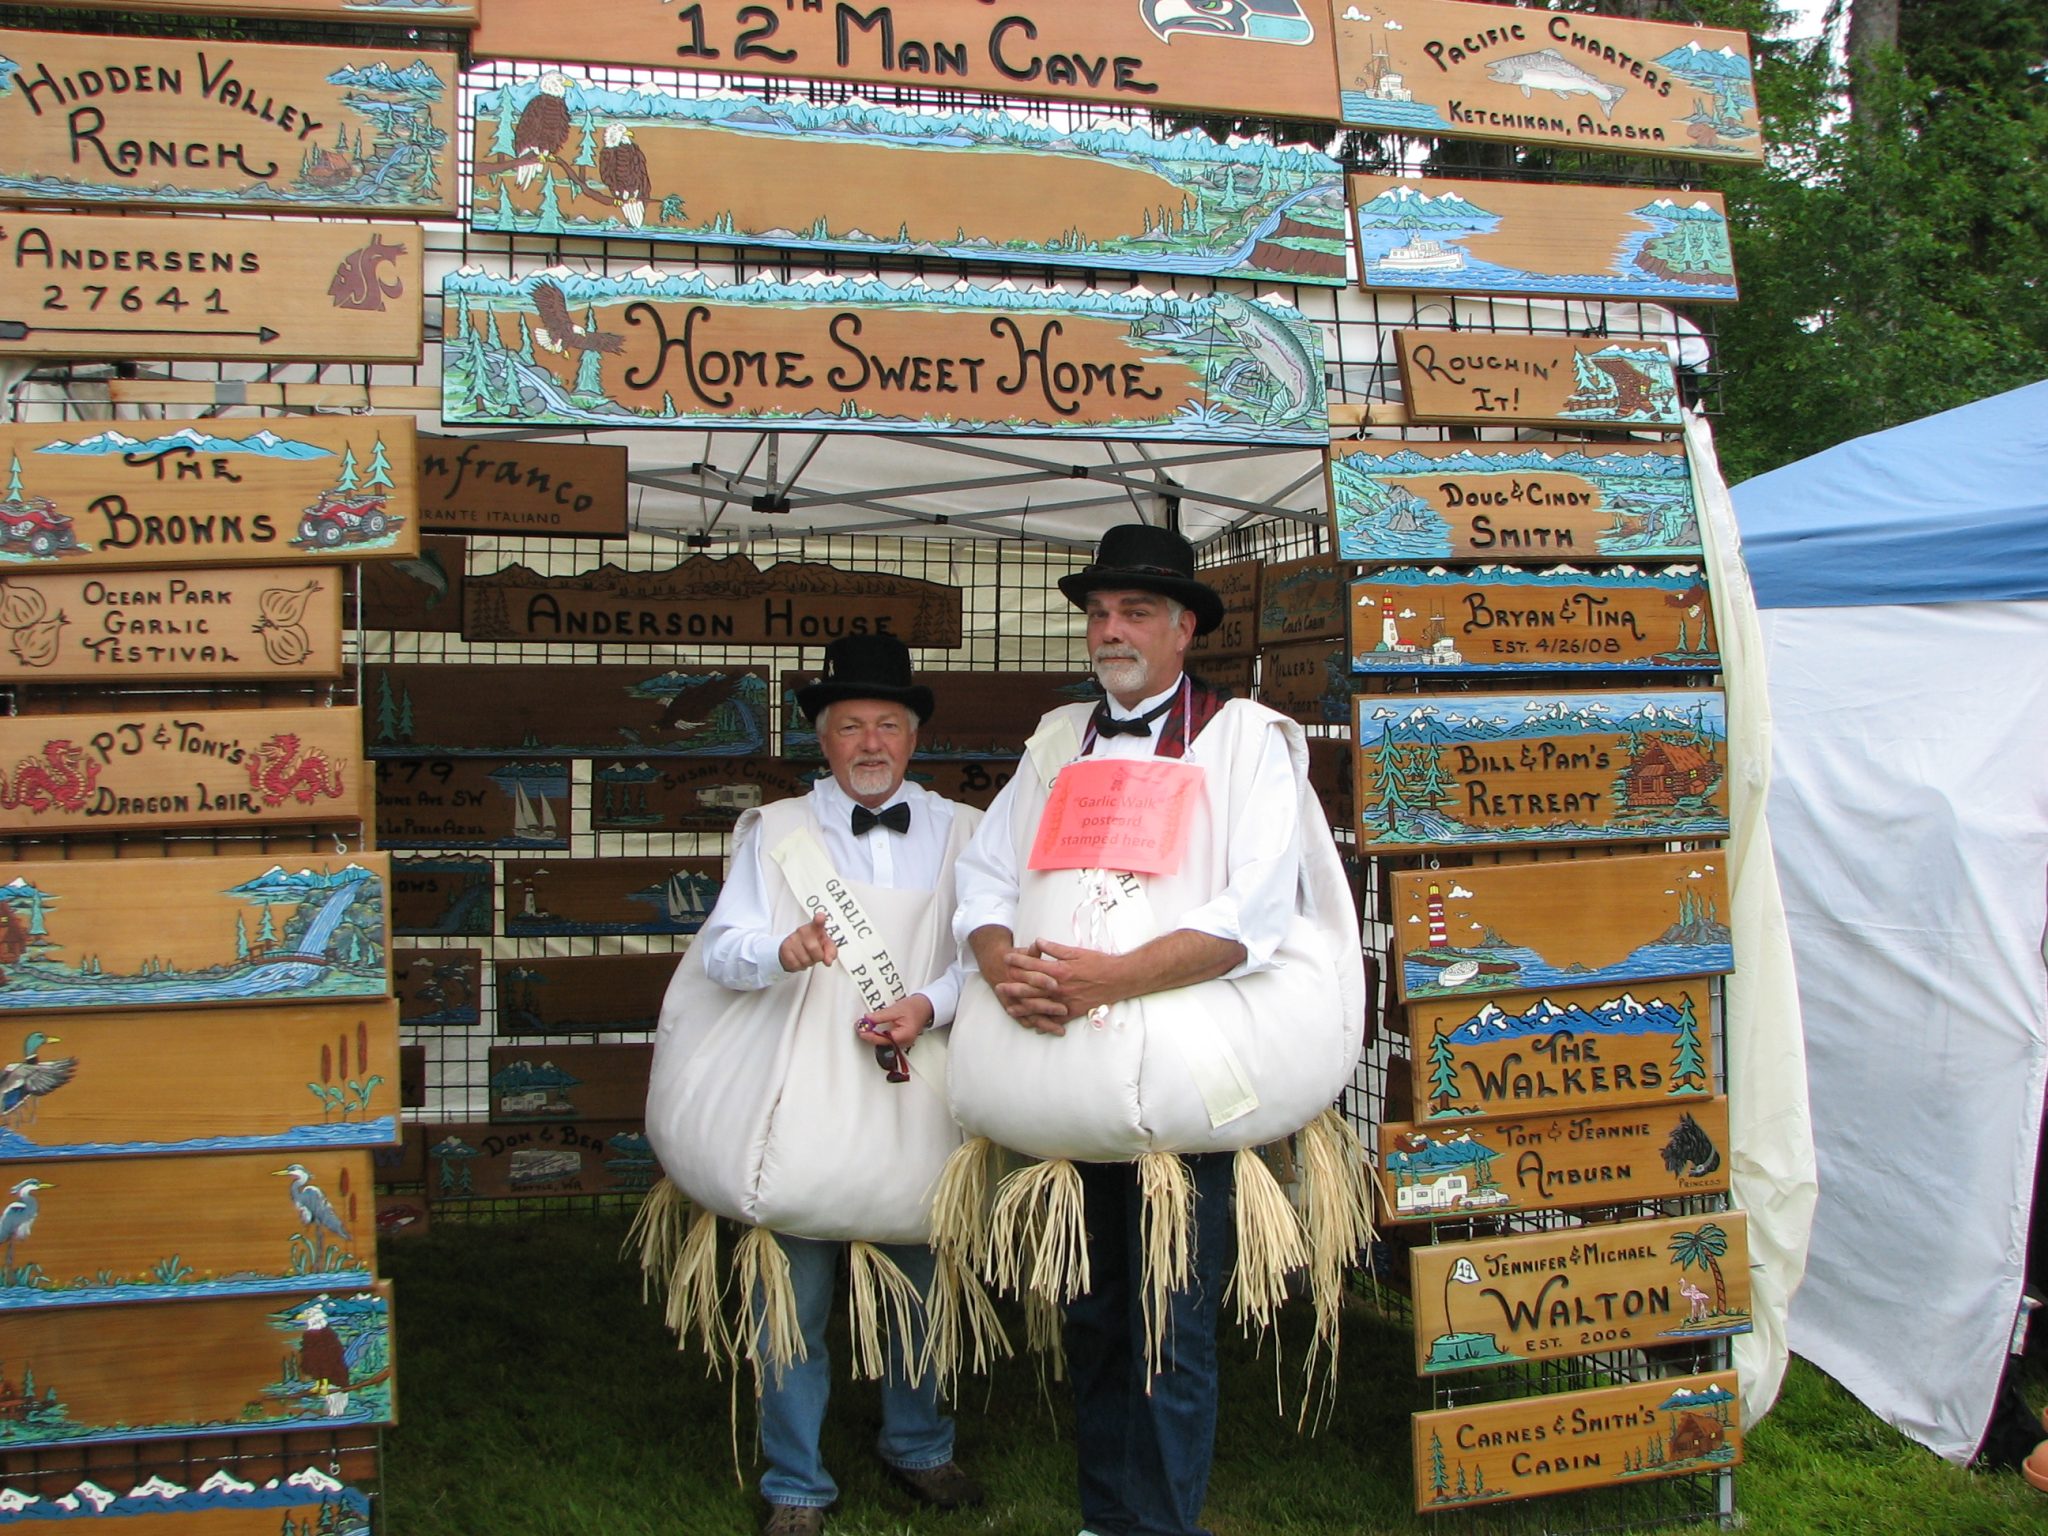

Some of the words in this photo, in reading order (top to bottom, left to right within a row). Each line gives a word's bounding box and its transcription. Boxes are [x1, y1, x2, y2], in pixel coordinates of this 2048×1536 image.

[836, 2, 968, 78] MAN
[989, 16, 1159, 93] CAVE
[1423, 23, 1527, 72] PACIFIC
[1548, 16, 1672, 98] CHARTERS
[14, 62, 183, 116] HIDDEN
[198, 52, 324, 140] VALLEY
[1448, 100, 1572, 136] KETCHIKAN,
[1577, 114, 1665, 142] ALASKA
[69, 106, 279, 178] RANCH
[16, 227, 260, 273] ANDERSENS
[44, 285, 230, 314] 27641
[624, 302, 814, 407] HOME
[827, 312, 984, 397] SWEET
[990, 318, 1163, 421] HOME
[1413, 345, 1558, 385] ROUGHIN'
[1472, 388, 1519, 411] IT!
[124, 446, 243, 483] THE
[418, 444, 593, 513] nfranco
[1439, 482, 1509, 508] DOUG
[1511, 479, 1523, 502] &
[1526, 482, 1591, 506] CINDY
[88, 495, 277, 551] BROWNS
[487, 511, 561, 525] ITALIANO
[1469, 514, 1574, 549] SMITH
[83, 580, 161, 606] OCEAN
[170, 579, 234, 605] PARK
[104, 611, 210, 636] GARLIC
[527, 593, 733, 637] ANDERSON
[765, 598, 897, 638] HOUSE
[1463, 592, 1555, 634] BRYAN
[1559, 599, 1575, 624] &
[1573, 593, 1646, 640] TINA
[83, 636, 239, 665] FESTIVAL
[1493, 639, 1529, 654] EST.
[1536, 637, 1622, 655] 4/26/08
[91, 723, 145, 765] PJ
[153, 723, 171, 750] &
[173, 720, 246, 766] TONY'S
[1455, 744, 1514, 775] BILL
[1520, 744, 1536, 771] &
[1538, 741, 1610, 770] PAM'S
[663, 764, 719, 791] SUSAN
[742, 760, 797, 793] CHUCK
[86, 786, 189, 815] DRAGON
[197, 783, 261, 815] LAIR
[1464, 780, 1601, 817] RETREAT
[1082, 815, 1143, 828] postcard
[1060, 833, 1119, 846] stamped
[1123, 833, 1156, 848] here
[825, 878, 873, 940] GARLIC
[1532, 1029, 1600, 1065] THE
[1461, 1052, 1663, 1100] WALKERS
[481, 1132, 530, 1157] DON
[1496, 1124, 1542, 1148] TOM
[1548, 1120, 1561, 1142] &
[1568, 1118, 1651, 1142] JEANNIE
[1516, 1151, 1632, 1199] AMBURN
[1484, 1252, 1567, 1278] JENNIFER
[1570, 1245, 1581, 1265] &
[1583, 1243, 1657, 1266] MICHAEL
[1480, 1274, 1670, 1333] WALTON
[1526, 1338, 1562, 1352] EST.
[1580, 1328, 1632, 1345] 2006
[1456, 1423, 1546, 1450] CARNES
[1553, 1414, 1566, 1436] &
[1571, 1405, 1656, 1436] SMITH'S
[1511, 1451, 1602, 1478] CABIN
